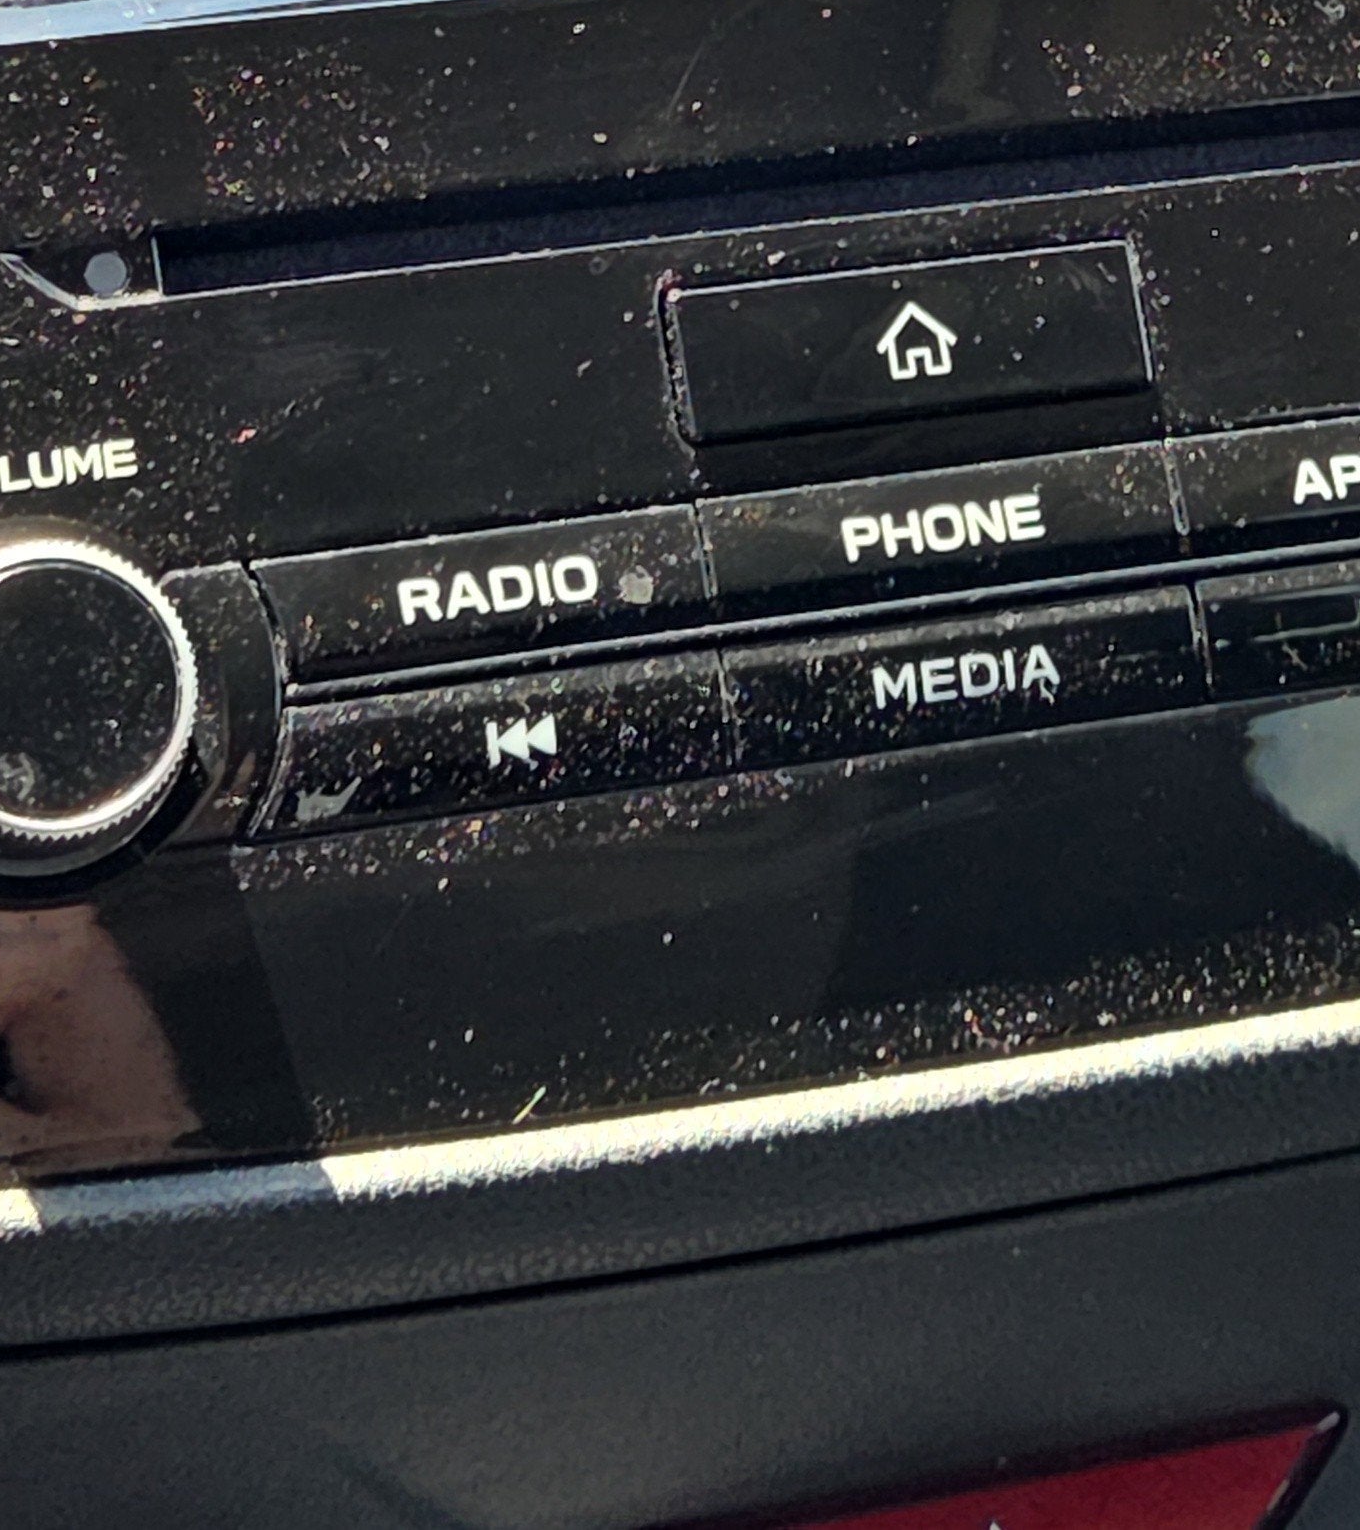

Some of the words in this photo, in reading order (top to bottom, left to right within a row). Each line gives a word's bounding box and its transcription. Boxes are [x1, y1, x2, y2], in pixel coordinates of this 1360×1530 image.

[841, 493, 1046, 563] PHONE
[397, 555, 600, 628] RADIO
[871, 644, 1061, 710] MEDIA
